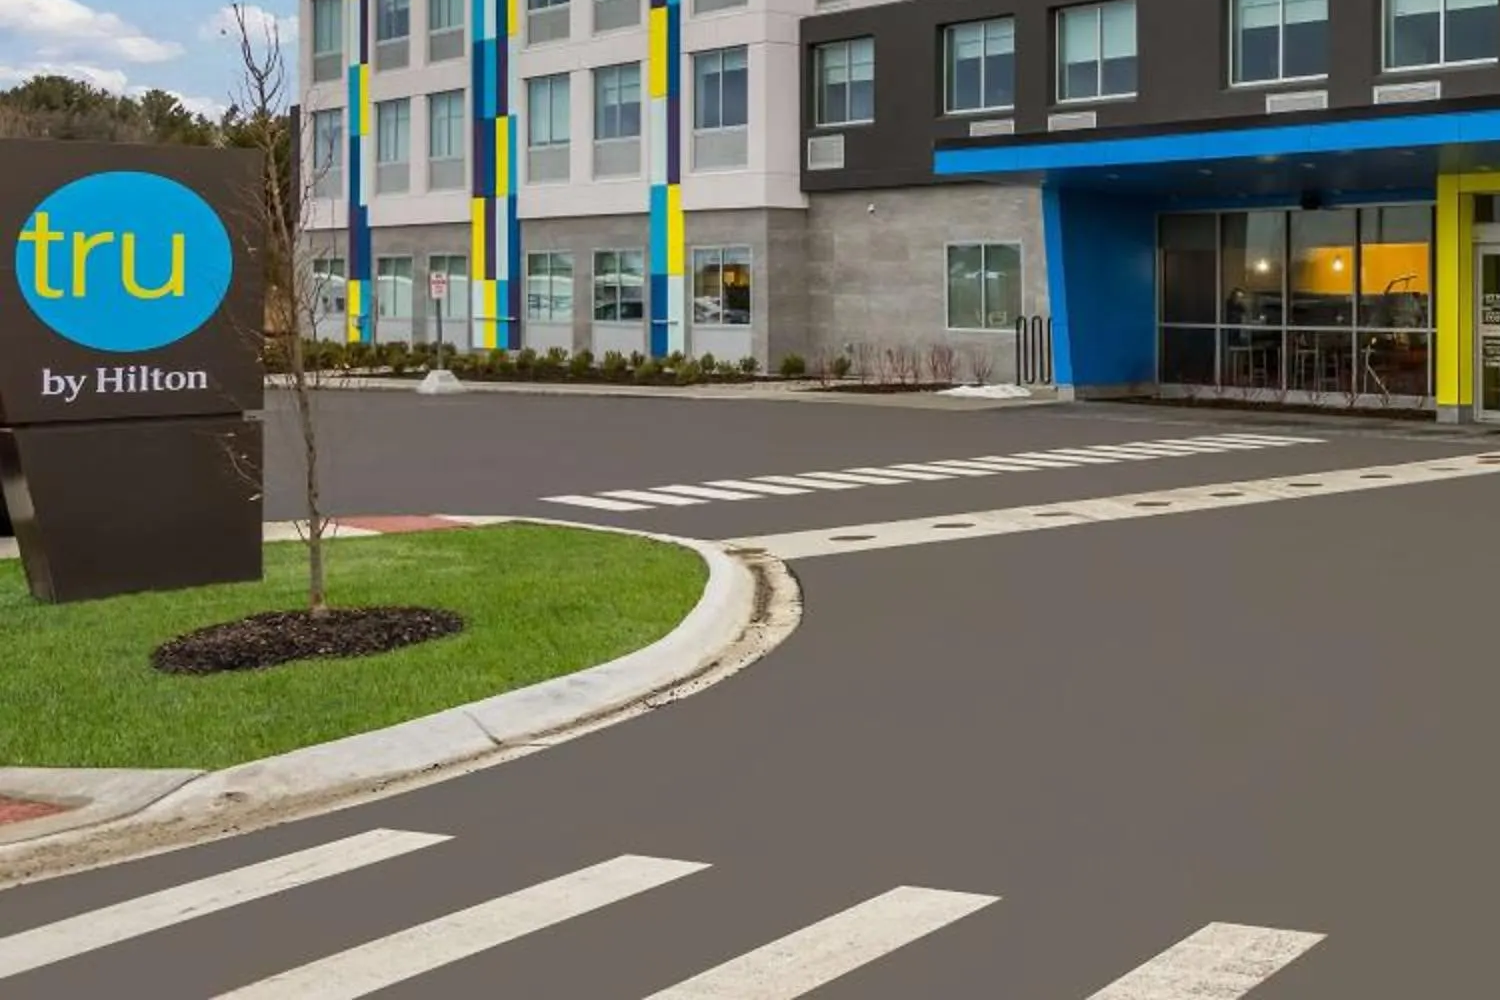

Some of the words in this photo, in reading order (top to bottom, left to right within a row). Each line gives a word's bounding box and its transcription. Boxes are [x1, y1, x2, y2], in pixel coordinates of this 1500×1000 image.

[19, 211, 186, 299] tru
[41, 368, 87, 402] by
[96, 365, 208, 393] Hilton
